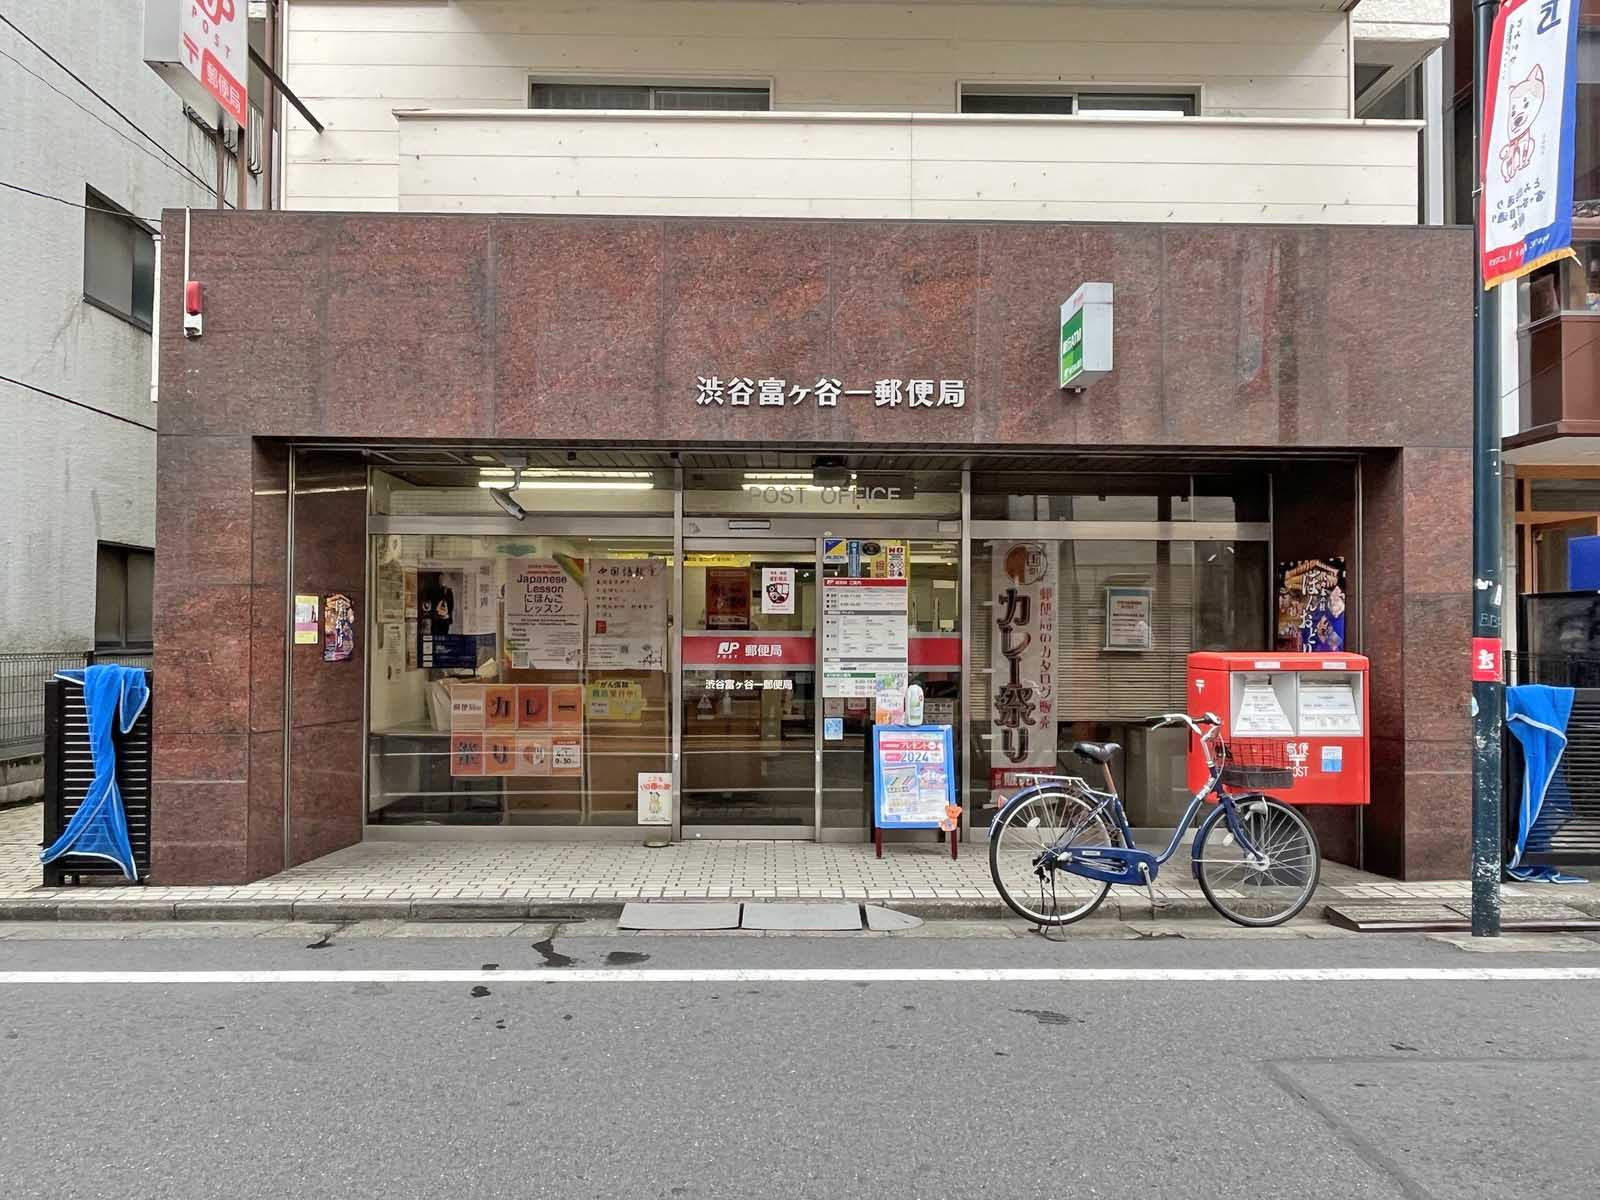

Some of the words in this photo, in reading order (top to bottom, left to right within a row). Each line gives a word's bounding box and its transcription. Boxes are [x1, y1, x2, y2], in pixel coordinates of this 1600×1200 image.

[191, 5, 231, 59] POST
[206, 62, 240, 113] 郵便局
[696, 376, 966, 408] 渋谷富ヶ谷一郵便局
[750, 486, 805, 504] POST
[820, 486, 901, 504] OFFICE
[516, 574, 568, 585] Japanese
[526, 583, 565, 594] Lesson
[524, 604, 564, 613] レッスン
[745, 644, 782, 657] 郵便局
[994, 588, 1037, 764] カレー祭り
[705, 679, 793, 690] 渋谷富ヶ谷一郵便局
[490, 695, 577, 719] カレー
[901, 751, 929, 762] 2024
